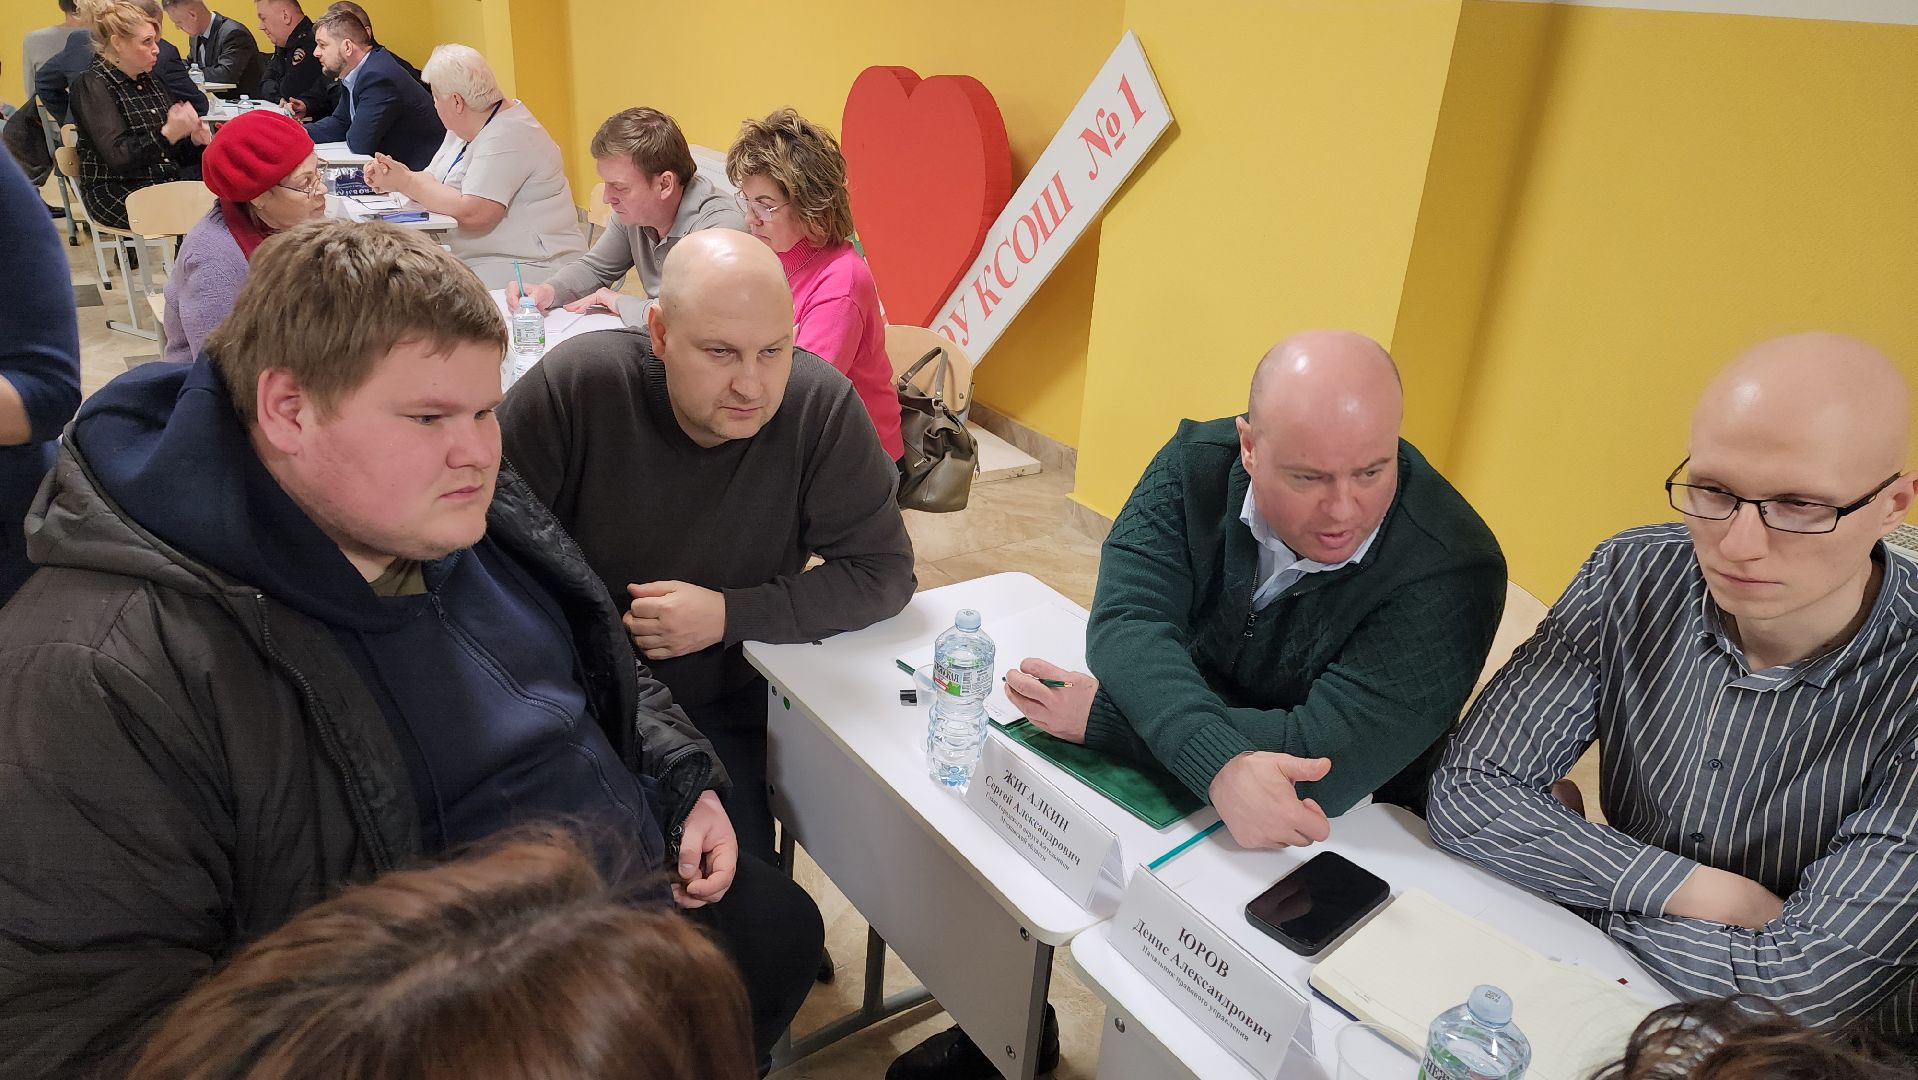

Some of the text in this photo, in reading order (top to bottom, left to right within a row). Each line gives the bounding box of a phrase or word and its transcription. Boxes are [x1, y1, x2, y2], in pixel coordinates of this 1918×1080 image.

[970, 170, 1074, 321] КСОШ
[985, 776, 1081, 866] Сергей Александрович
[1003, 769, 1069, 833] ЖИГАЛКИН
[1132, 917, 1273, 1043] Денис Александрович
[1142, 944, 1249, 1041] Начальник правового управления
[1178, 926, 1230, 978] ЮРОВ
